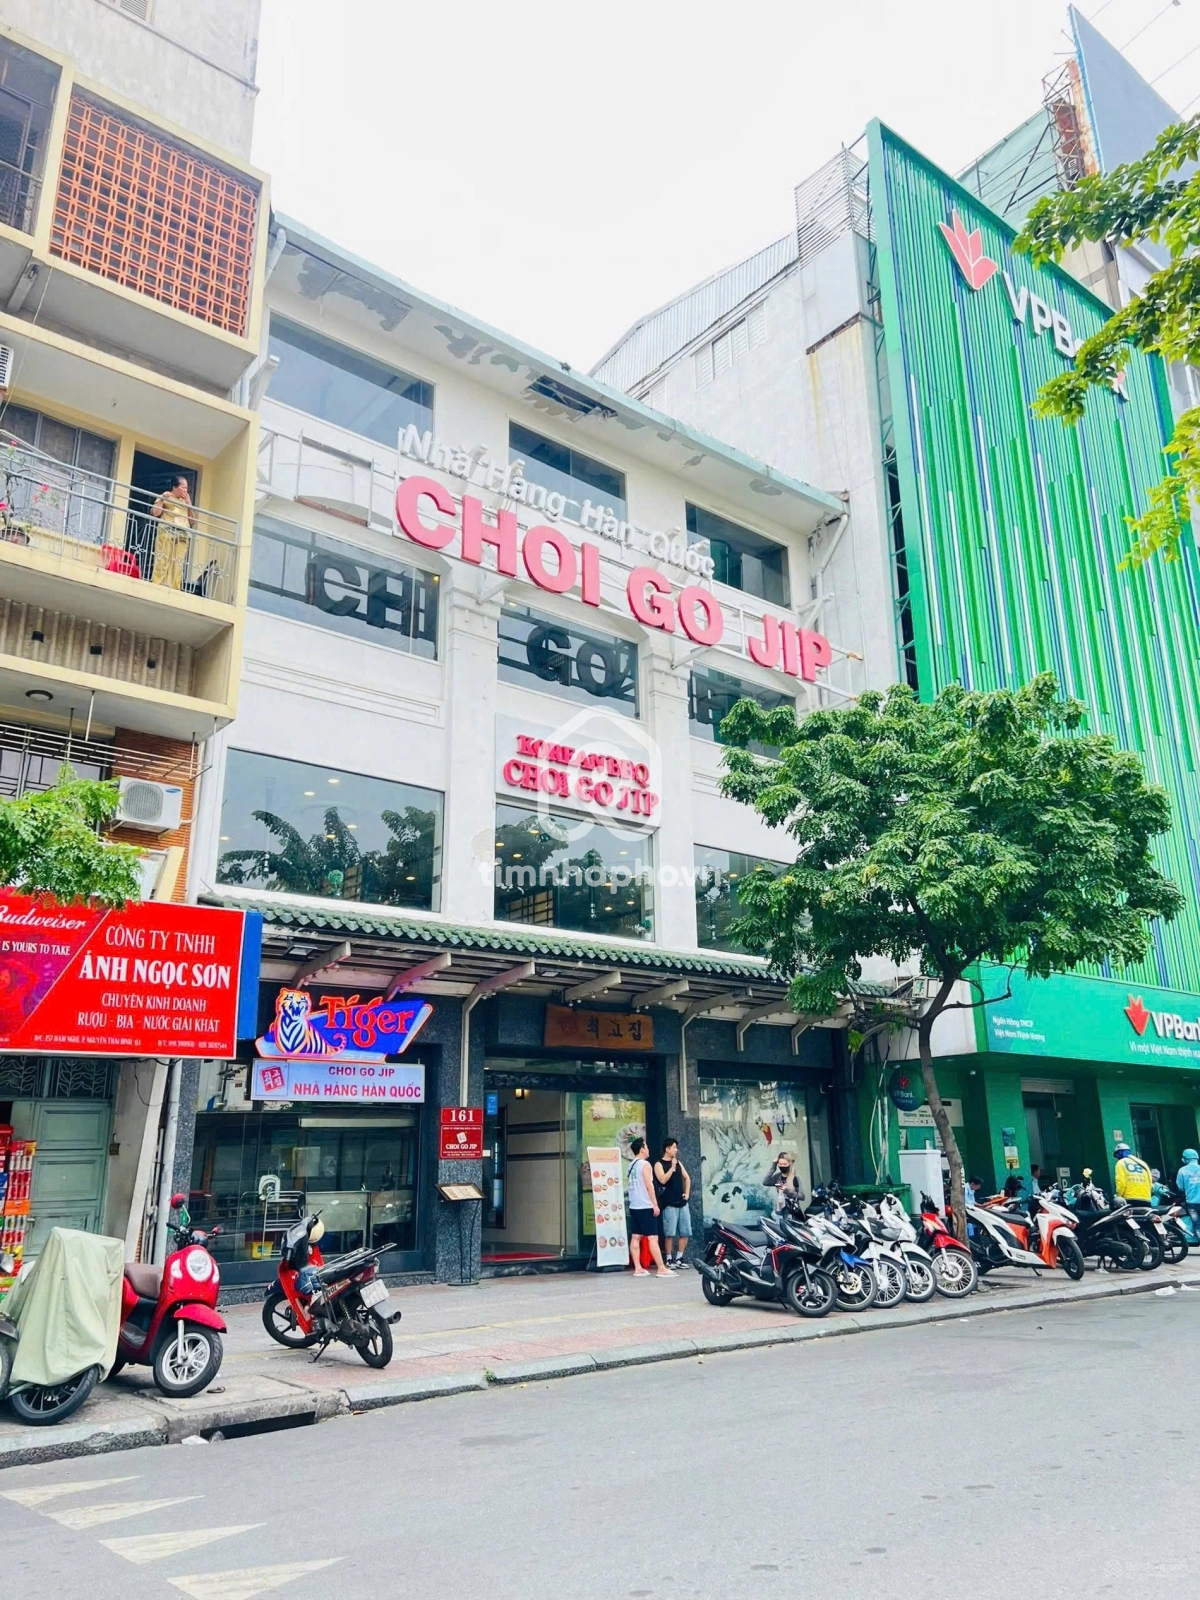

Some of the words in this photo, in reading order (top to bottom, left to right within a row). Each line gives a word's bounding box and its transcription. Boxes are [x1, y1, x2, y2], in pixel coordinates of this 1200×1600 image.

[395, 475, 601, 608] CHOI
[626, 566, 724, 647] GO
[748, 613, 832, 683] JIP
[503, 758, 571, 798] CHOI
[575, 775, 615, 806] GO
[616, 786, 660, 816] JIP
[1, 940, 10, 951] IS
[12, 941, 37, 954] YOURS
[39, 943, 50, 954] TO
[51, 944, 71, 956] TAKE
[105, 924, 146, 949] CÔNG
[149, 930, 170, 950] TY
[174, 932, 215, 954] TNHH
[132, 958, 189, 990] NGỌC
[191, 963, 231, 989] SƠN
[101, 992, 144, 1009] CHUYÊN
[146, 995, 171, 1010] KINH
[172, 997, 207, 1012] DOANH
[77, 1011, 107, 1029] RƯỢU
[116, 1014, 134, 1028] BIA
[319, 994, 414, 1048] Tiger
[328, 1066, 356, 1076] CHOI
[359, 1067, 375, 1077] GO
[378, 1068, 395, 1077] JIP
[293, 1081, 320, 1096] NHÀ
[324, 1082, 358, 1096] HÀNG
[361, 1082, 386, 1097] HÀN
[389, 1082, 421, 1098] QUỐC
[450, 1109, 475, 1122] 161
